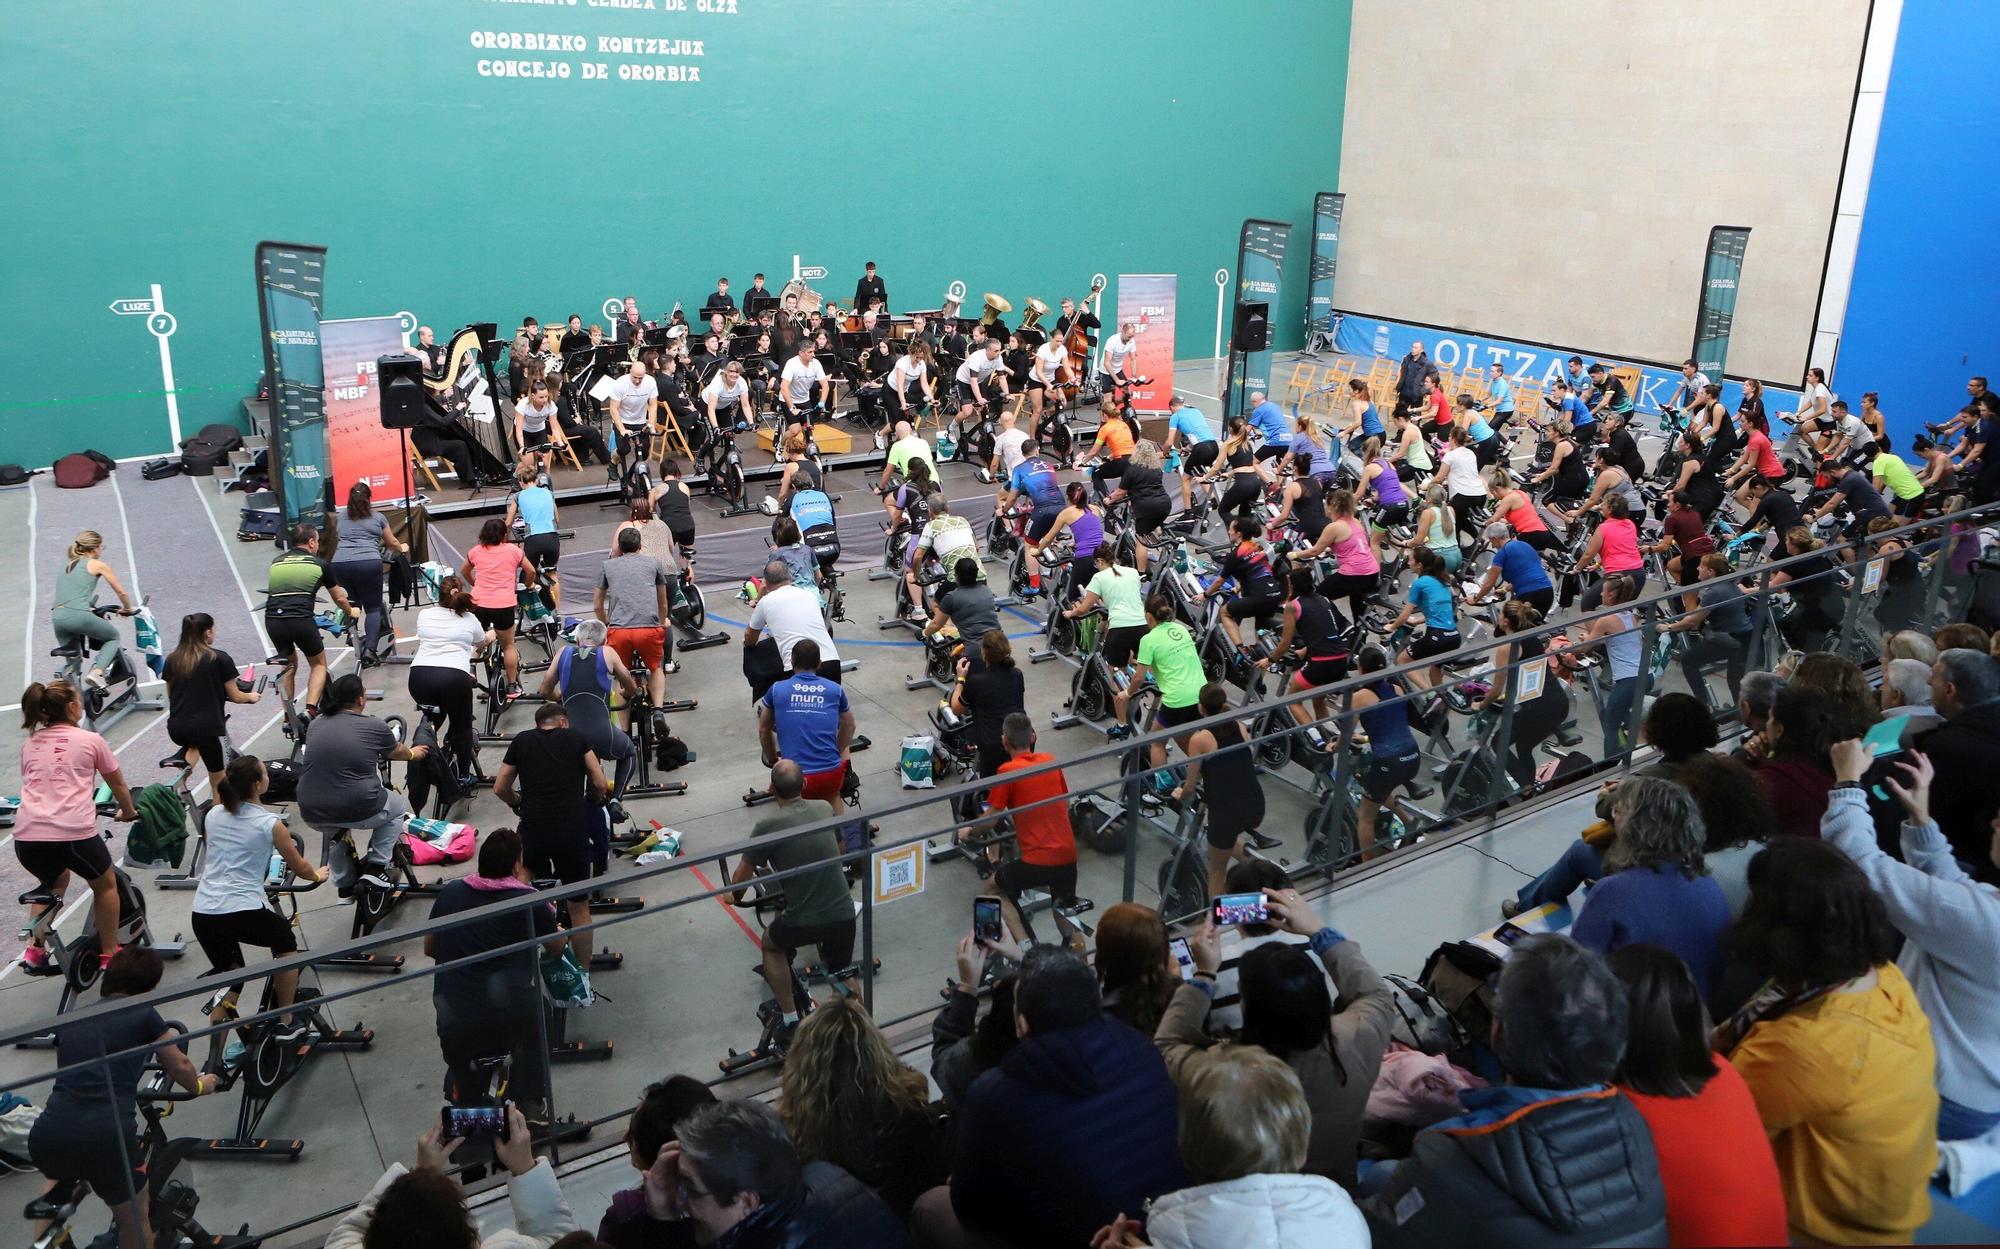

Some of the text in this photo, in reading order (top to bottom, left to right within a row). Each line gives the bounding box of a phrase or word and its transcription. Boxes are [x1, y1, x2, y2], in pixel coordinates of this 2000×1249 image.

[696, 0, 738, 14] OLZA
[470, 31, 704, 56] ORORBIAKO KONTZEJUA
[477, 59, 701, 82] CONCEJO DE ORORBIA
[122, 302, 151, 311] LUZE
[1140, 306, 1165, 316] FBM
[157, 319, 166, 329] 7
[401, 319, 409, 328] 6
[356, 361, 377, 374] FB
[334, 386, 368, 400] MBF
[1132, 391, 1141, 399] N
[790, 693, 825, 704] muro
